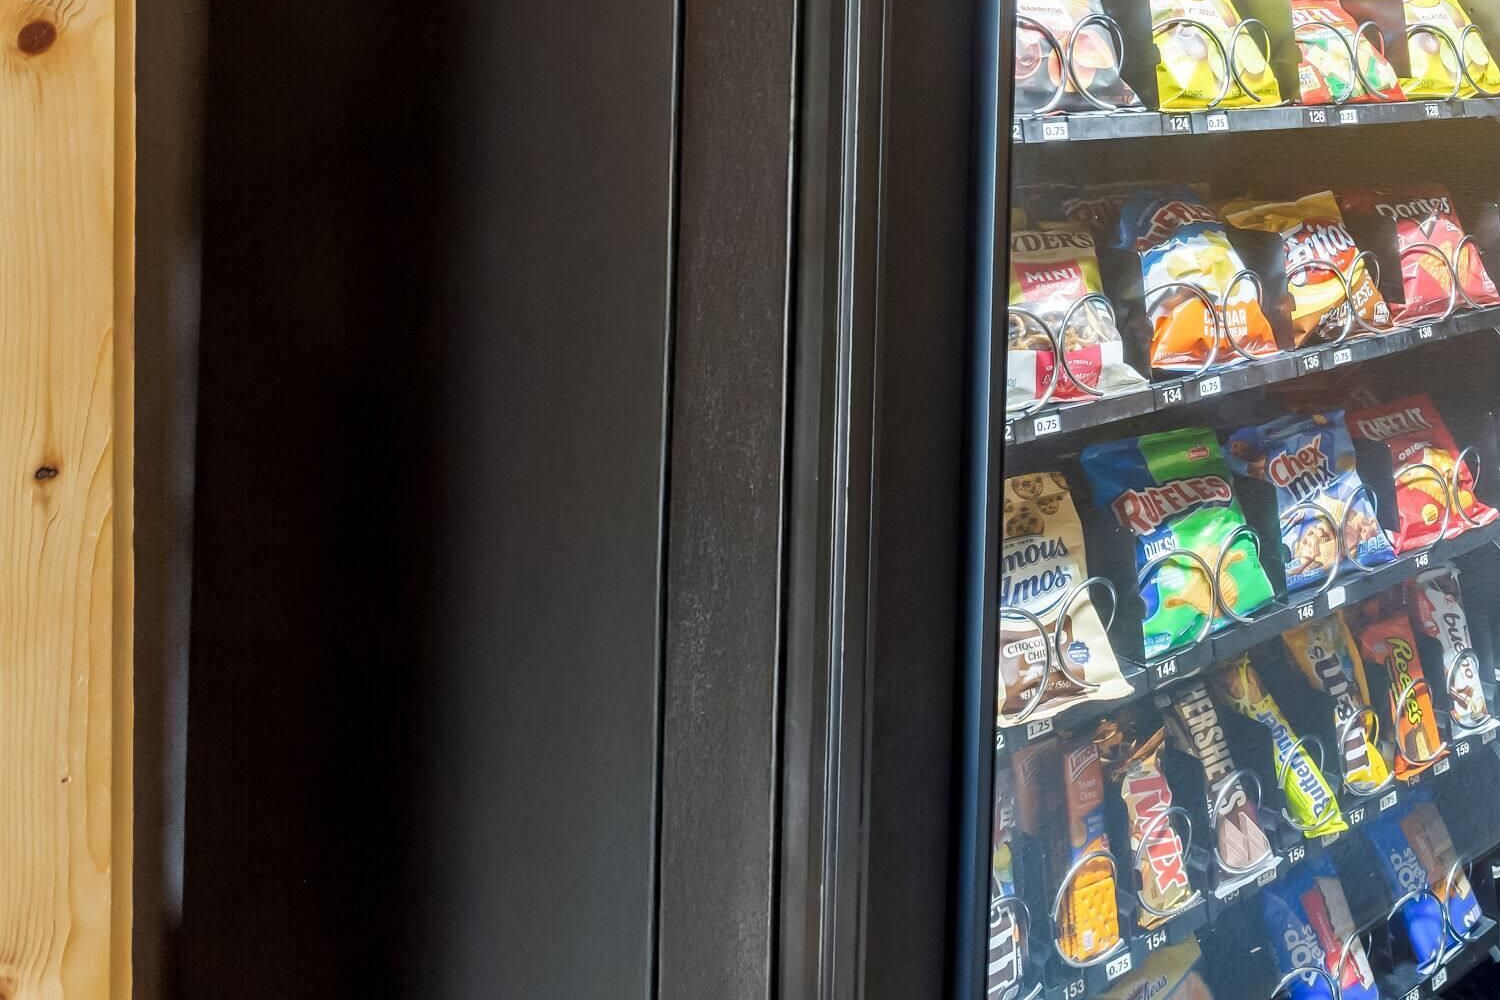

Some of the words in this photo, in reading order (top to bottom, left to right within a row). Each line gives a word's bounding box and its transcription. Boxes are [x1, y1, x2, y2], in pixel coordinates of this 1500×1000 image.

[1309, 110, 1326, 123] 126
[1424, 105, 1440, 116] 128
[1045, 125, 1066, 137] 0.75
[1170, 117, 1189, 131] 124
[1208, 119, 1226, 129] 0.75
[1375, 196, 1450, 218] Doritos
[1024, 266, 1076, 284] MINI
[1418, 326, 1433, 339] 138
[1302, 356, 1319, 370] 136
[1334, 352, 1349, 363] 0.75
[1201, 381, 1218, 393] 0.75
[1162, 388, 1183, 404] 134
[1037, 420, 1058, 432] 0.75
[1269, 434, 1328, 487] Chex
[1112, 475, 1232, 535] RUFFLES
[1144, 535, 1178, 560] QUESO
[1414, 554, 1429, 568] 148
[1297, 605, 1314, 621] 146
[1156, 660, 1177, 679] 144
[1385, 636, 1424, 725] Reese's
[1029, 722, 1050, 736] 1.25
[1455, 743, 1470, 758] 159
[1349, 809, 1365, 825] 157
[1287, 847, 1305, 863] 156
[1146, 930, 1168, 951] 154
[1108, 958, 1129, 975] 0.75
[1063, 979, 1085, 1000] 153
